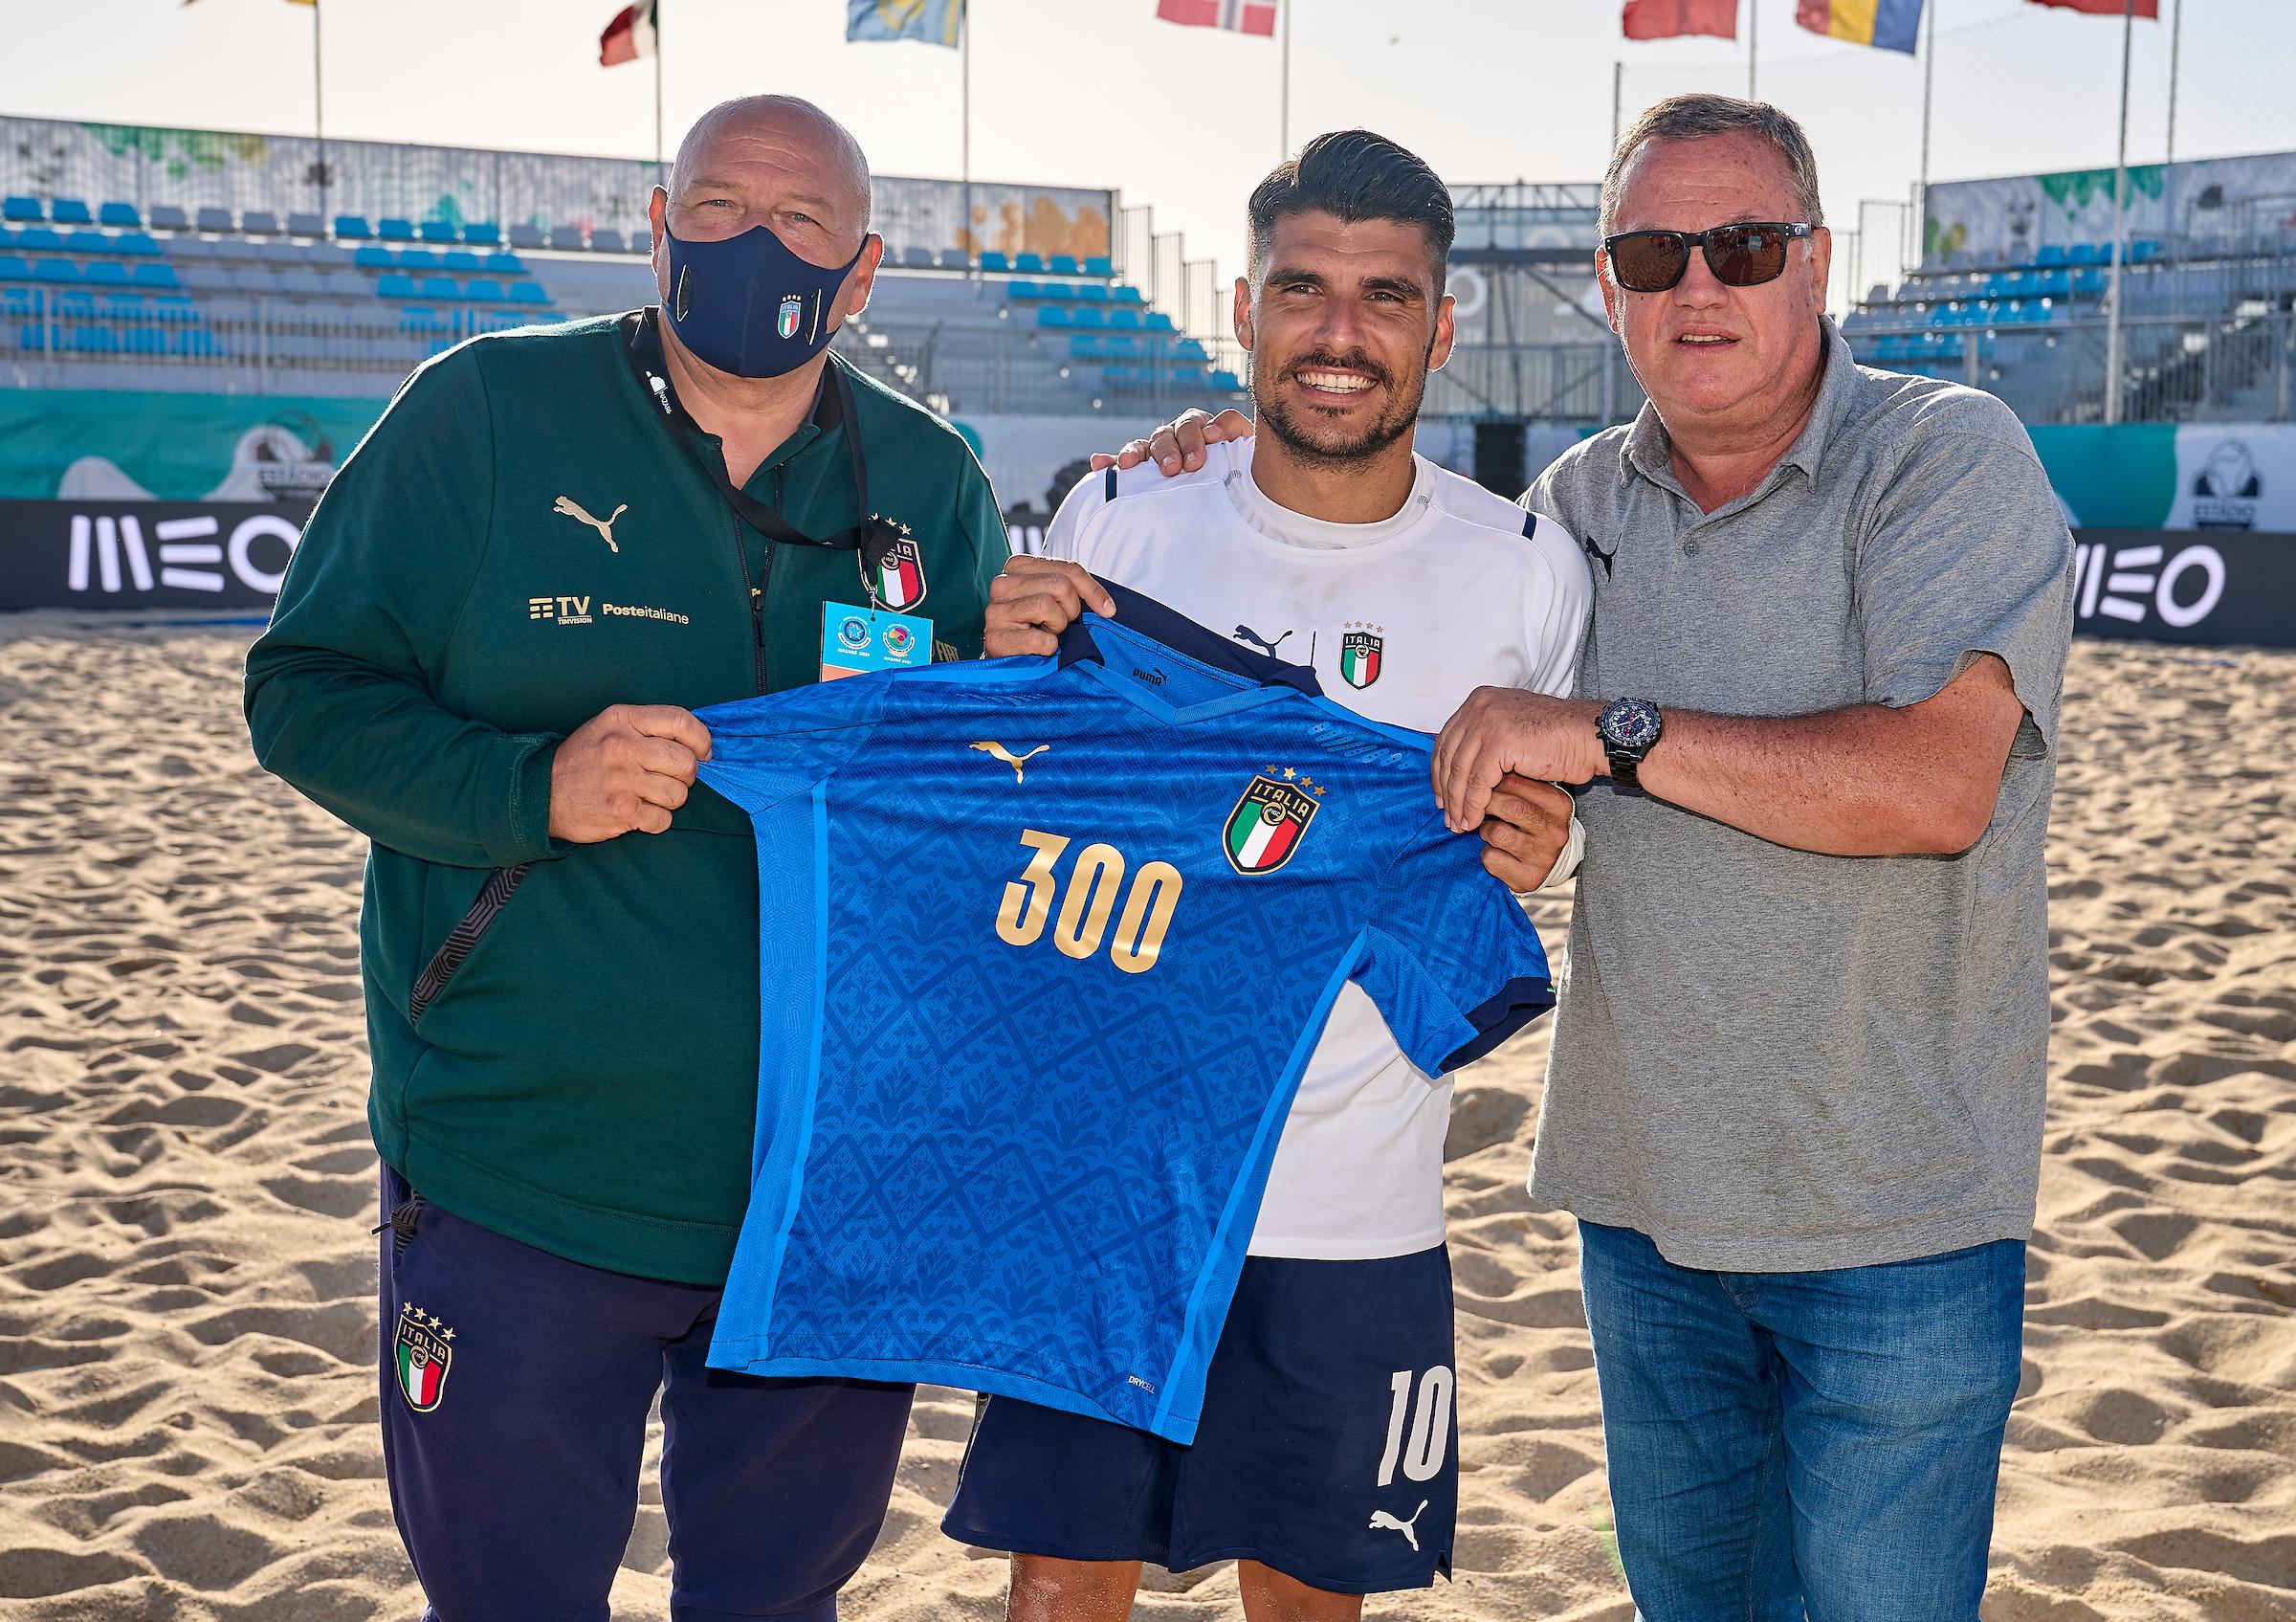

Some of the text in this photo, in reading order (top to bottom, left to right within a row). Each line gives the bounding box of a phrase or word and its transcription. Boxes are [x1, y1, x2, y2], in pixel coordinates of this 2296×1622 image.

[68, 515, 302, 593] MEO
[556, 596, 590, 616] TV
[603, 603, 690, 625] Posteitaliane
[1346, 635, 1380, 648] ITALIA
[1133, 668, 1162, 686] PUMA
[1254, 783, 1310, 817] ITALIA
[1268, 808, 1281, 817] FIGC
[995, 829, 1183, 974] 300
[403, 1324, 446, 1360] ITALIA
[1129, 1375, 1156, 1394] DRYCELL
[1377, 1365, 1454, 1487] 10
